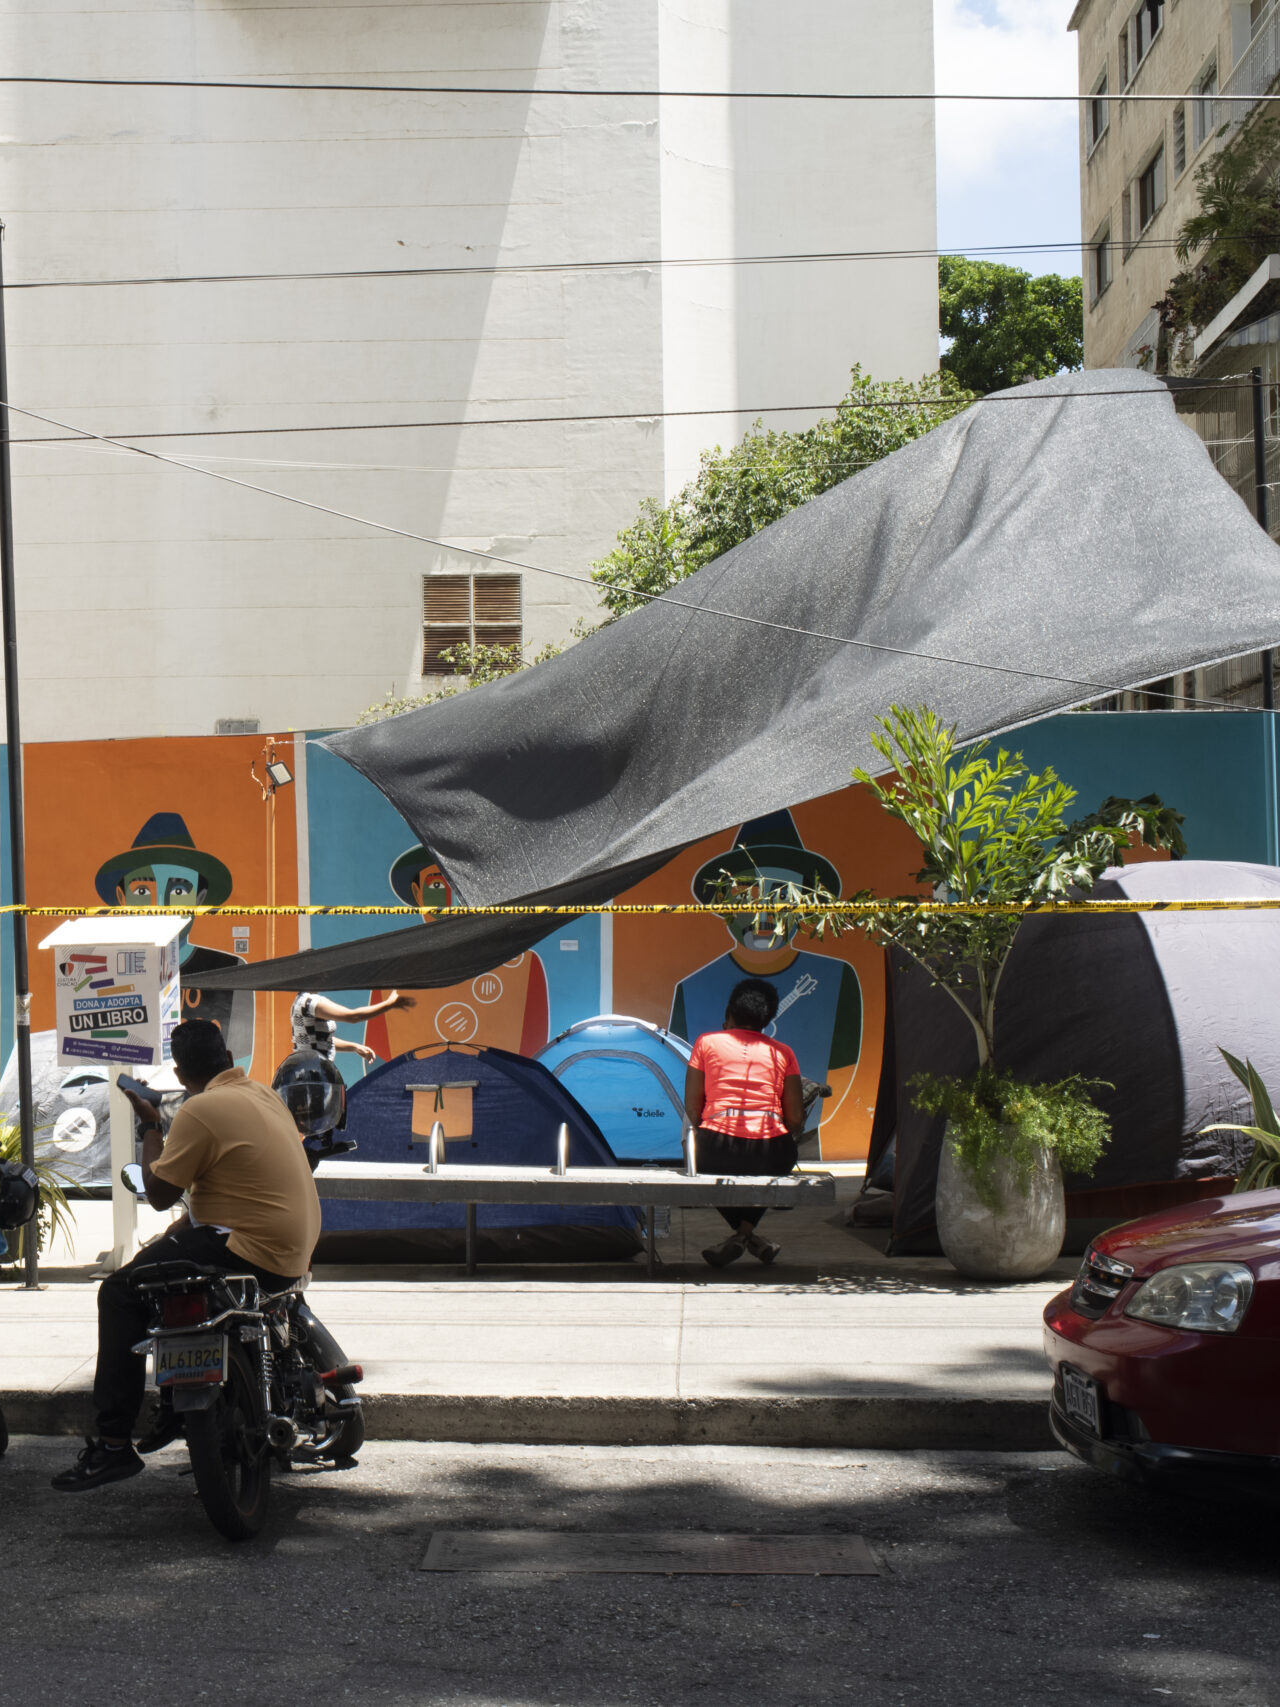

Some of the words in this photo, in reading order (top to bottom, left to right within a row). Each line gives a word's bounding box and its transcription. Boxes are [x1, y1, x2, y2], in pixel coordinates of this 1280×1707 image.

[76, 999, 98, 1009] DONA
[108, 997, 140, 1007] ADOPTA
[72, 1016, 94, 1030] UN
[98, 1009, 144, 1027] LIBRO
